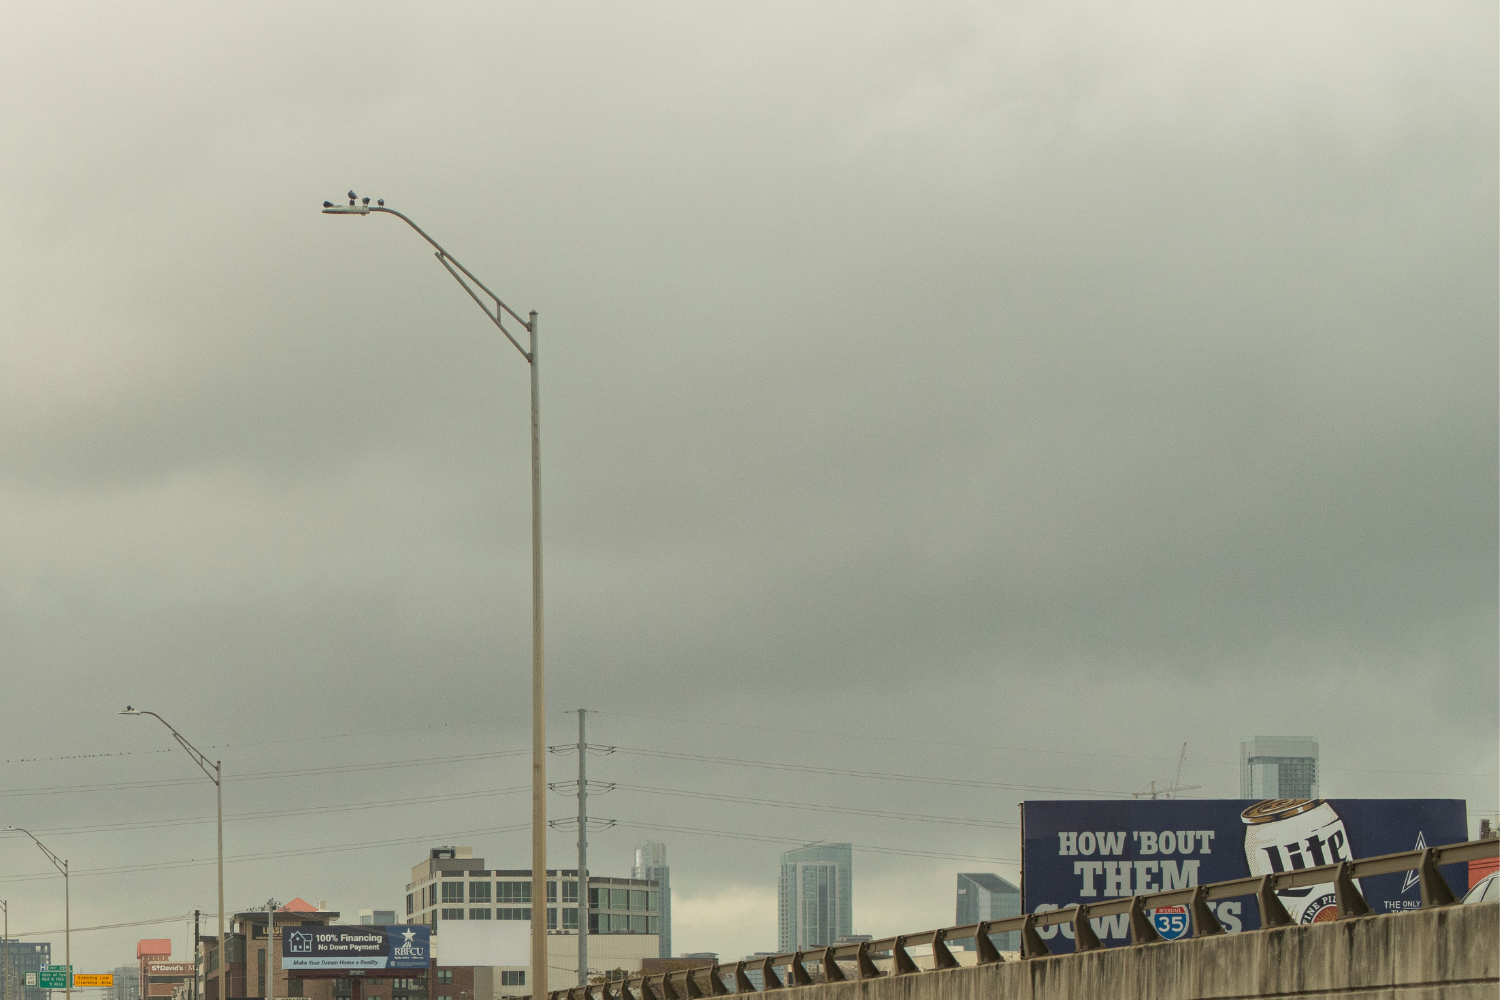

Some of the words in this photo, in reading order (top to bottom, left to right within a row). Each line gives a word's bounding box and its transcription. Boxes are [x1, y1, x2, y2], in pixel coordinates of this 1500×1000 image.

[1058, 831, 1126, 855] HOW
[1133, 830, 1215, 855] 'BOUT
[1074, 859, 1200, 897] THEM
[1322, 895, 1338, 905] PIL
[1384, 901, 1400, 909] THE
[1403, 900, 1421, 908] ONLY
[1158, 916, 1184, 932] 35
[316, 934, 338, 942] 100%
[341, 934, 383, 943] Financing
[394, 948, 424, 956] RBFCU
